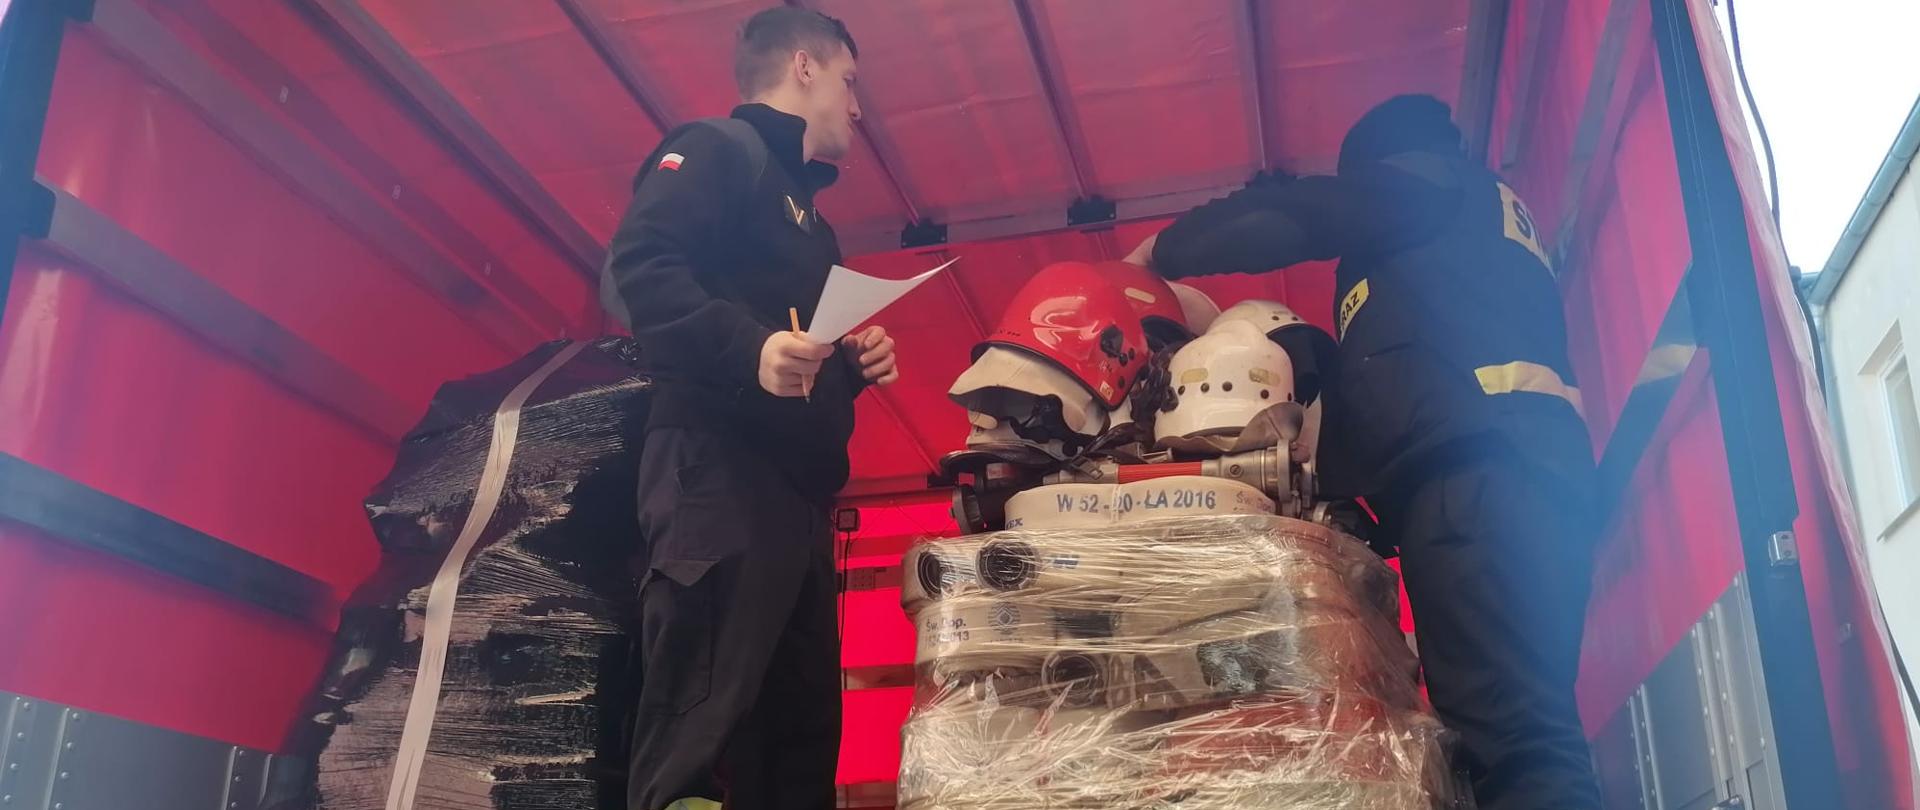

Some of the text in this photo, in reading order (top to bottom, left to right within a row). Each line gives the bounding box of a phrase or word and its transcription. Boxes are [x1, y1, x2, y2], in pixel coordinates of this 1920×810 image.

[1056, 493, 1074, 513] W
[1079, 493, 1099, 514] 52
[1172, 489, 1217, 510] 2016
